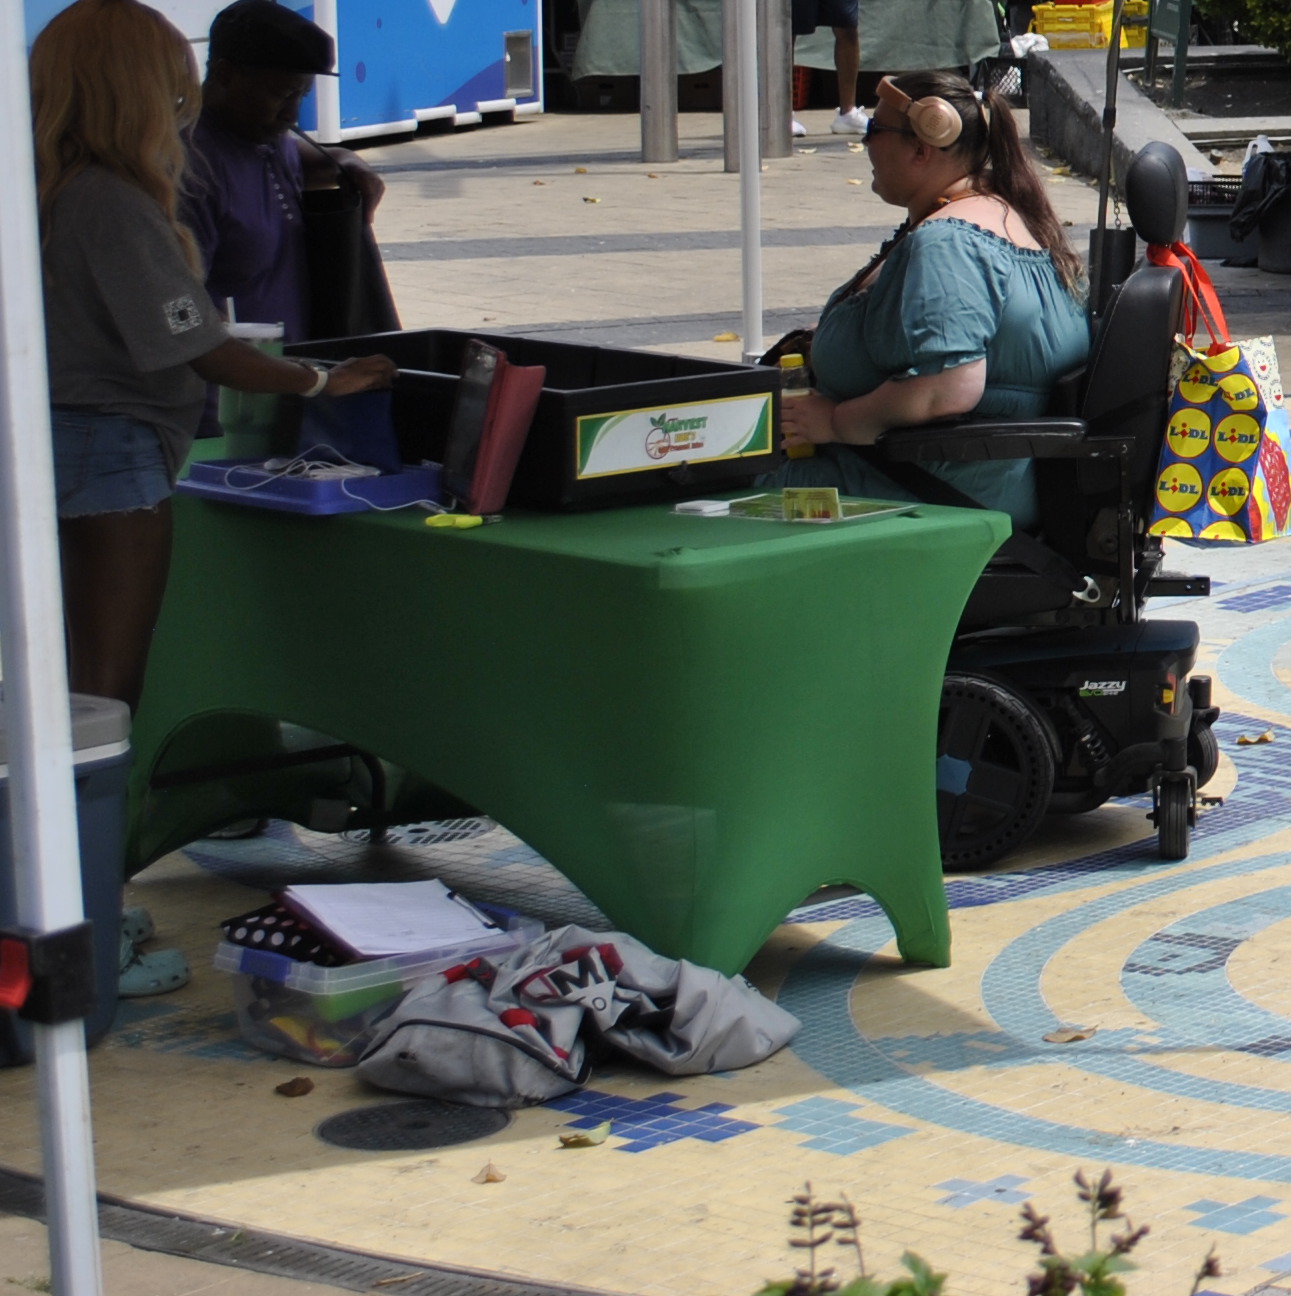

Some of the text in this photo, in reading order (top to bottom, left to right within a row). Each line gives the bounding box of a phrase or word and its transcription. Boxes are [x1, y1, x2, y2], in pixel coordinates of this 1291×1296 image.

[1170, 422, 1208, 440] LIDL
[1218, 427, 1258, 445] LIDL
[1159, 477, 1199, 495] LIDL
[1211, 482, 1246, 498] LIDL
[1079, 680, 1126, 692] Jazzy
